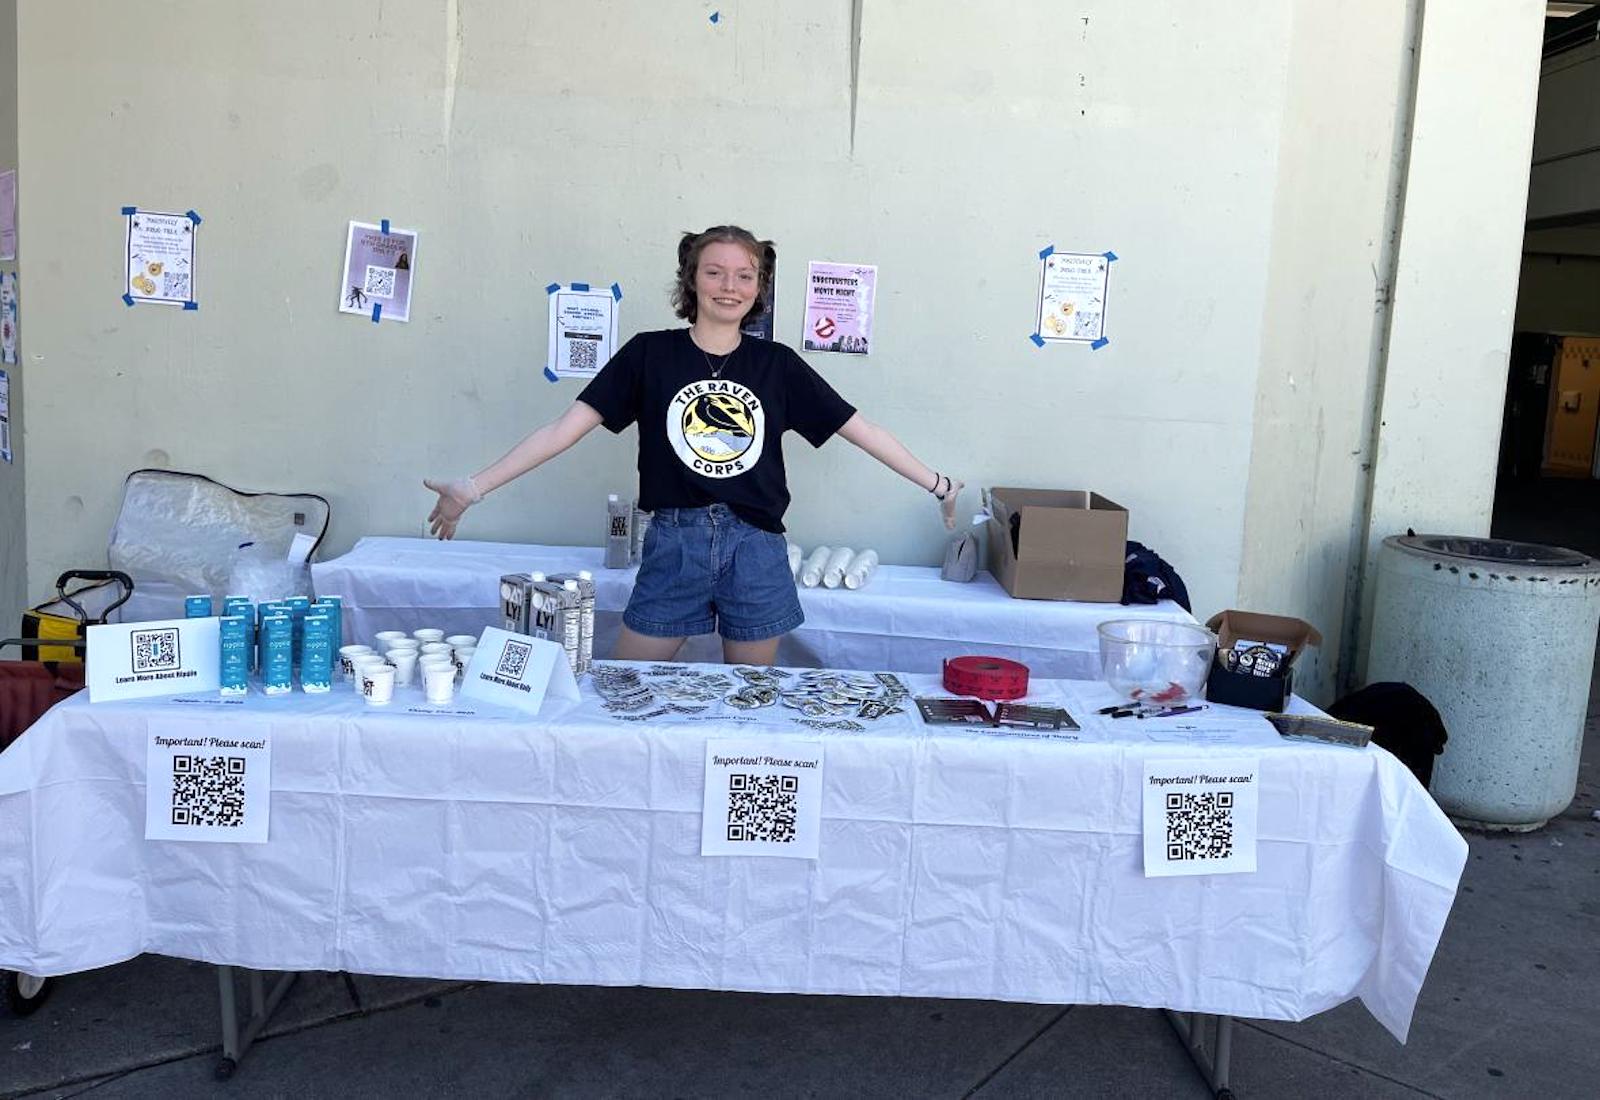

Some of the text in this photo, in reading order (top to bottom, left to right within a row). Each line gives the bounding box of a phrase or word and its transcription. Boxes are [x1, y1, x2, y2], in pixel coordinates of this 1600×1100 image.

[675, 383, 760, 411] THE RAVEN
[693, 459, 744, 475] CORPS
[506, 601, 521, 621] LY!
[536, 610, 554, 631] LY!
[480, 672, 493, 680] Learn
[494, 676, 505, 684] More
[154, 736, 265, 749] Important! Please scan!
[712, 755, 819, 769] Important! Please scan!
[1149, 773, 1254, 787] Important! Please scan!
